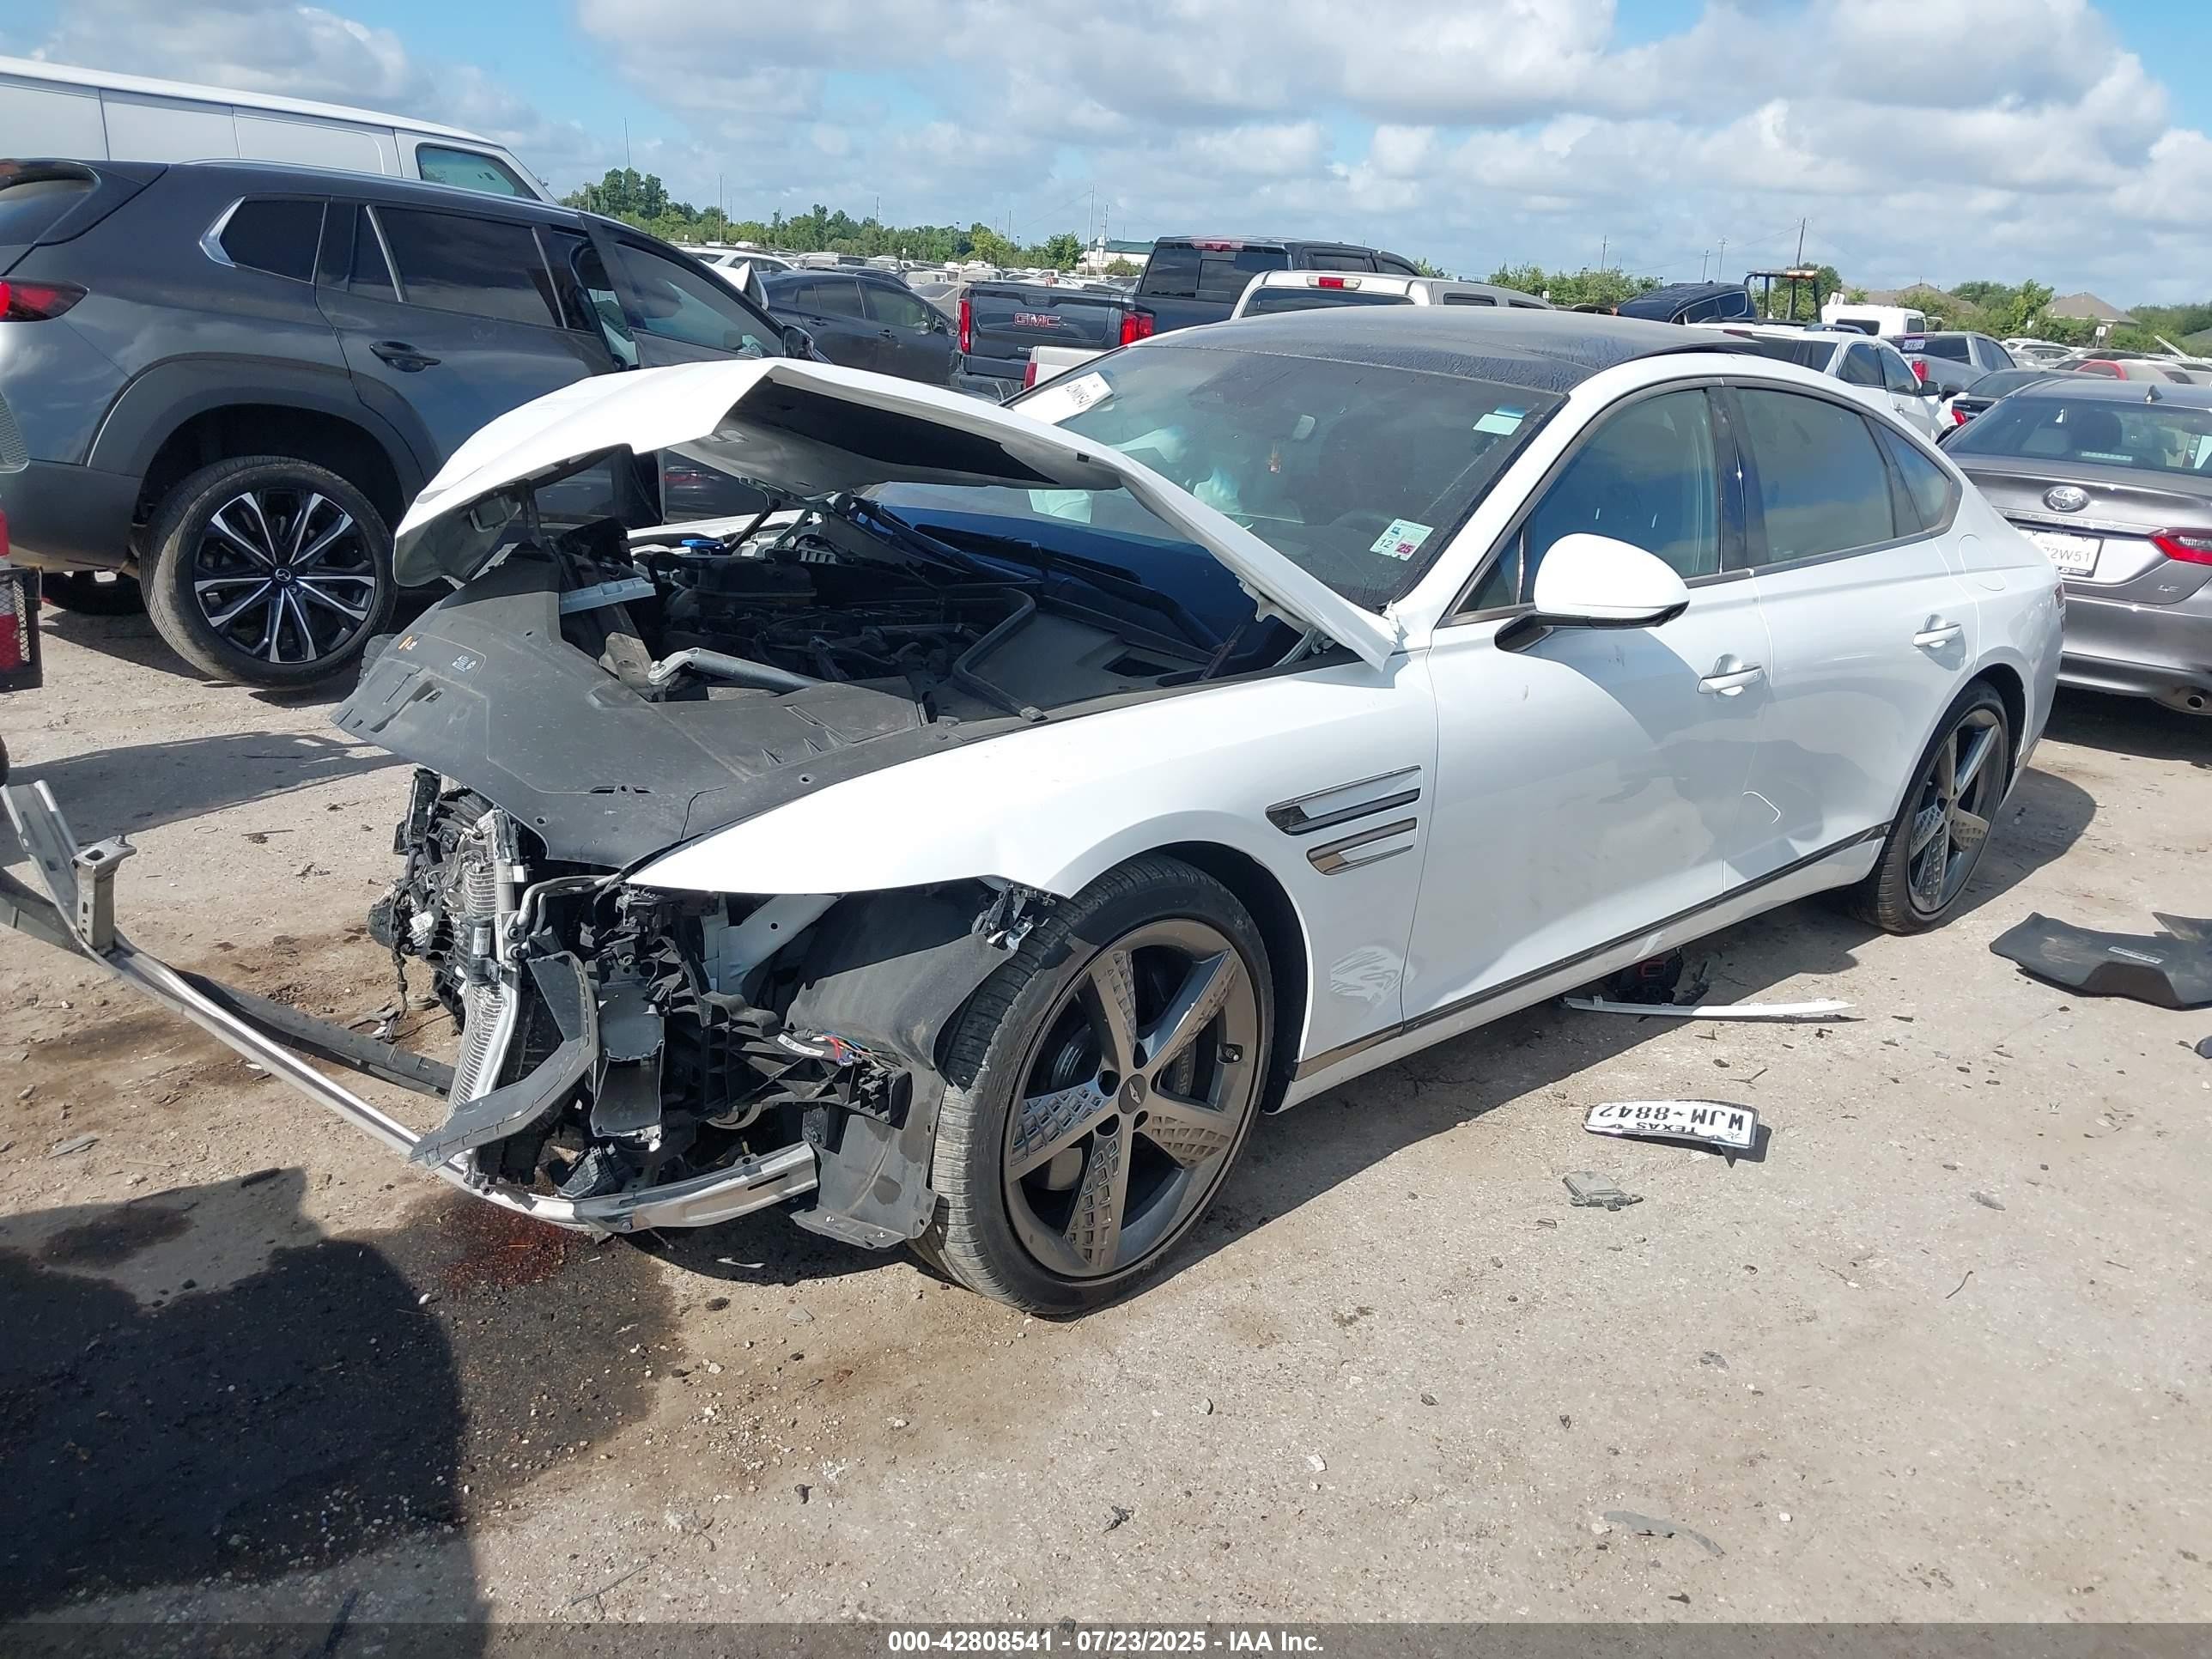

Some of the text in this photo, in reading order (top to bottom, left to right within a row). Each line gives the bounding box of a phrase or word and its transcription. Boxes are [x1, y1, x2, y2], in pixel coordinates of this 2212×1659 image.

[1014, 313, 1061, 329] GMC
[1379, 538, 1394, 549] 12
[1394, 544, 1413, 554] 25
[1636, 1121, 1698, 1135] TEXAS
